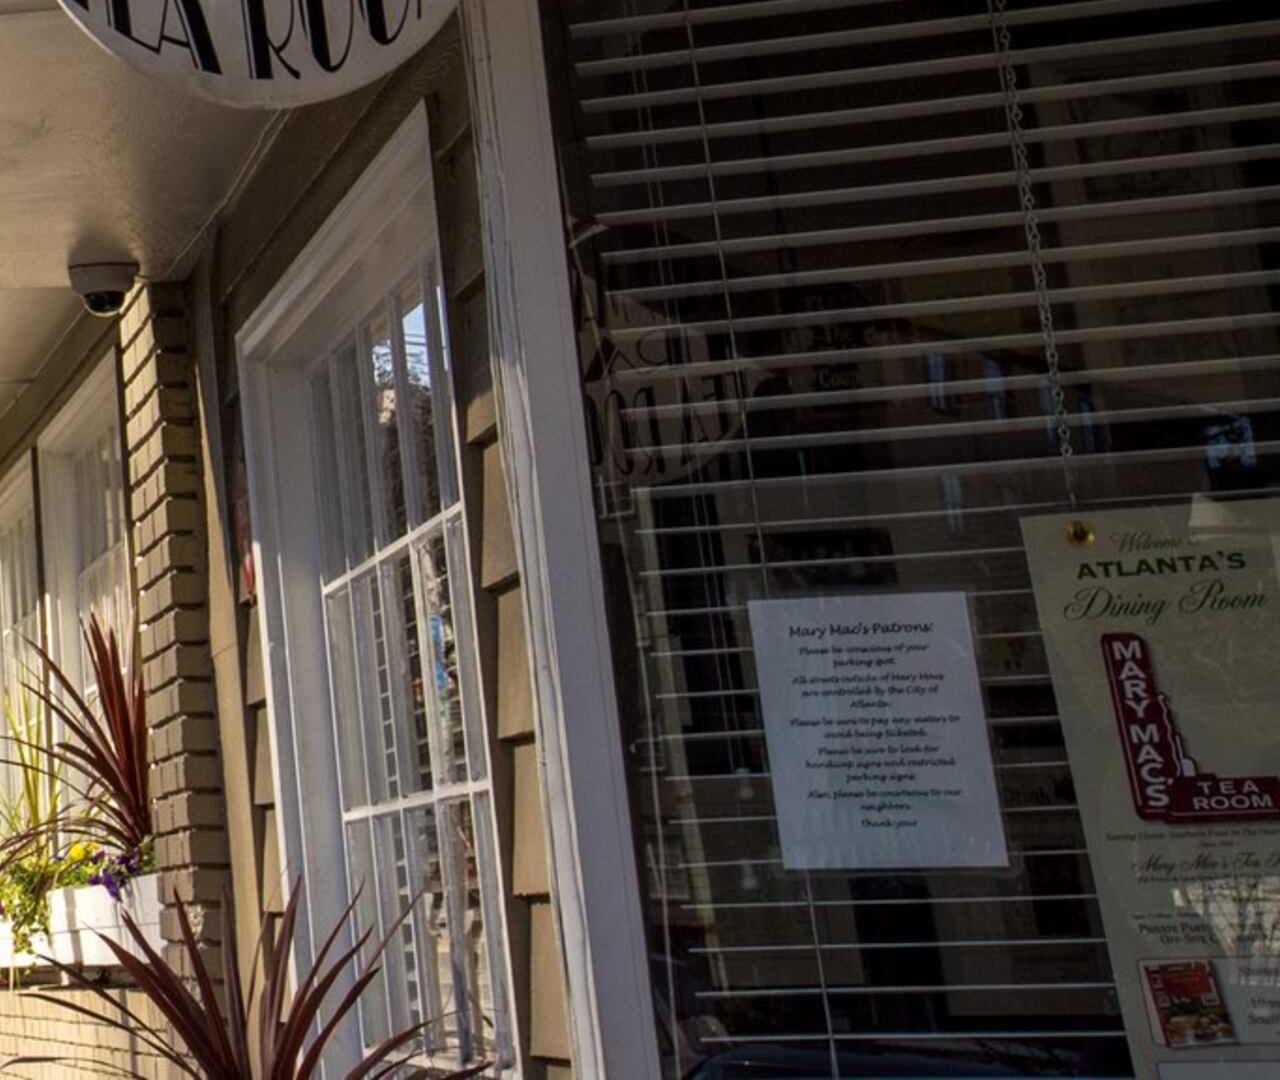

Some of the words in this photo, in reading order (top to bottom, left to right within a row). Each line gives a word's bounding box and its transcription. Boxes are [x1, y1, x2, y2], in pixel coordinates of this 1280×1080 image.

[1077, 550, 1246, 580] ATLANTA'S
[1064, 585, 1170, 626] Dining
[1179, 579, 1269, 615] Room
[789, 626, 826, 639] Mary
[829, 622, 870, 636] Mac's
[905, 644, 929, 653] your
[833, 658, 873, 668] parking
[892, 674, 917, 683] Mary
[1111, 640, 1149, 719] MARY
[821, 687, 871, 697] controlled
[874, 686, 885, 696] by
[888, 686, 903, 695] the
[906, 686, 926, 696] City
[928, 685, 938, 693] of
[871, 717, 889, 727] pay
[824, 730, 851, 739] avoid
[854, 729, 882, 740] being
[907, 758, 956, 768] restricted
[1129, 723, 1174, 808] MAC'S
[846, 773, 886, 784] parking
[1197, 780, 1260, 795] TEA
[1192, 794, 1273, 811] ROOM
[861, 819, 894, 828] Thank
